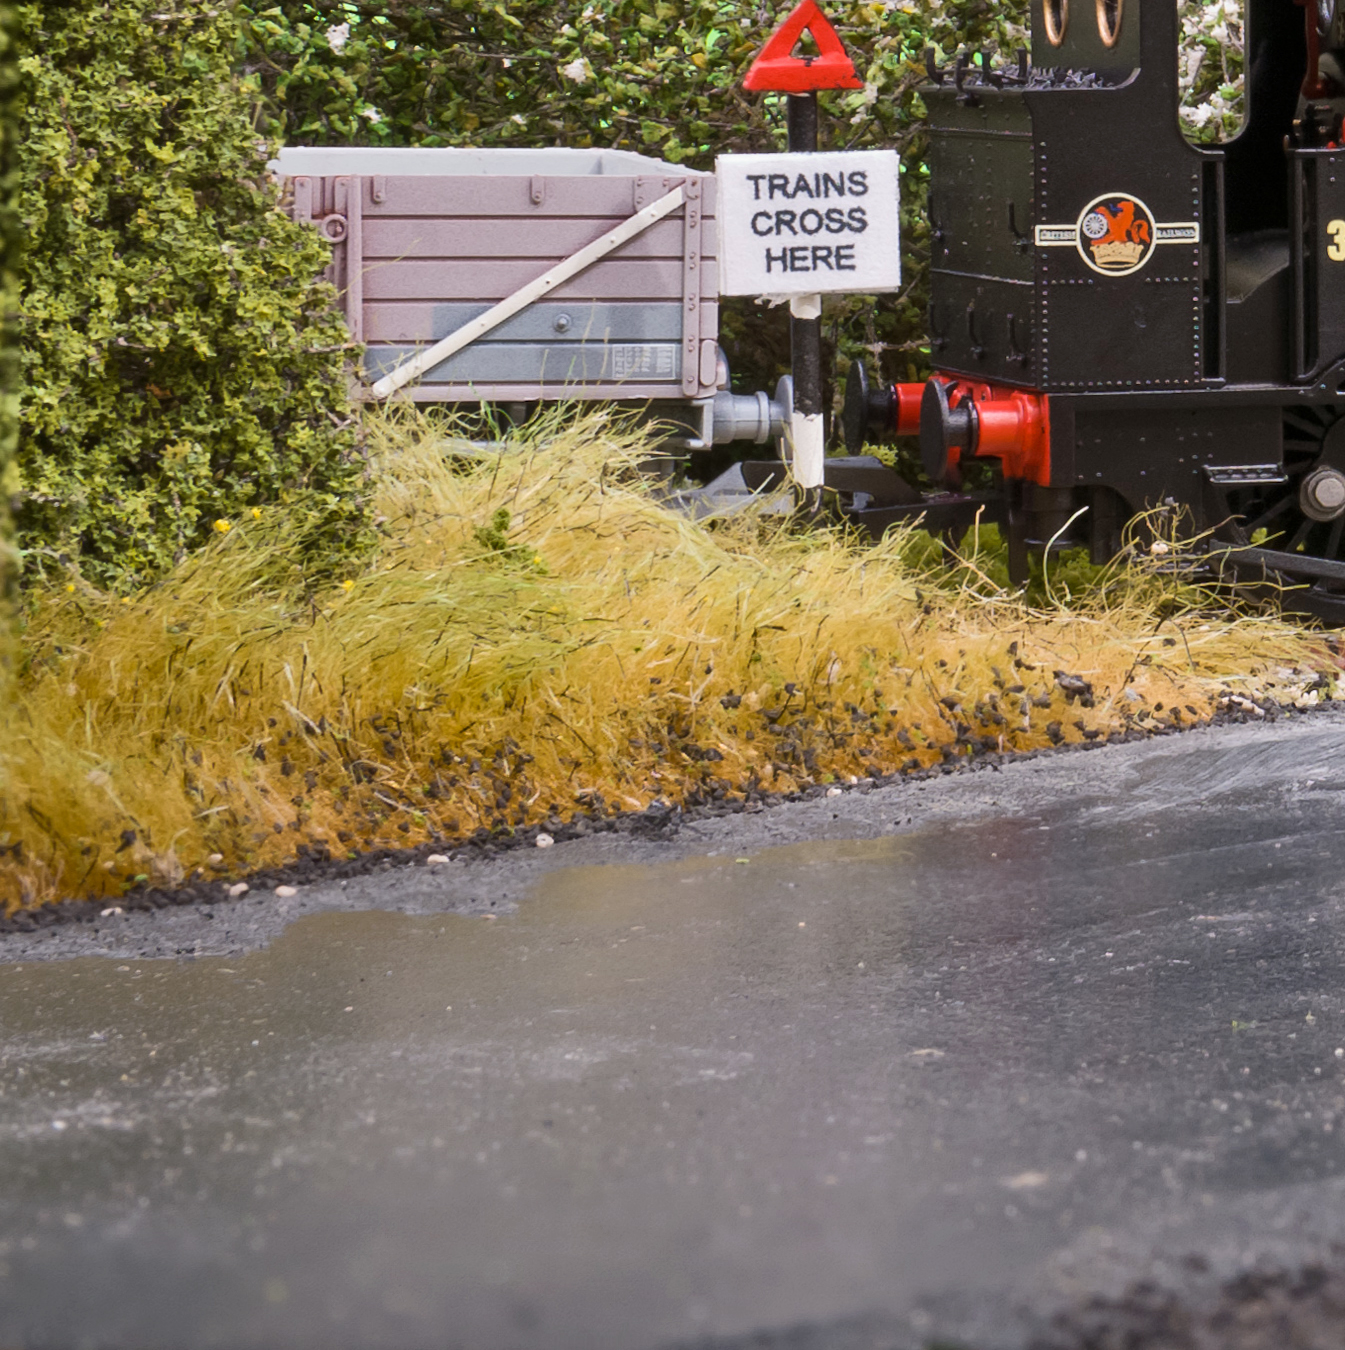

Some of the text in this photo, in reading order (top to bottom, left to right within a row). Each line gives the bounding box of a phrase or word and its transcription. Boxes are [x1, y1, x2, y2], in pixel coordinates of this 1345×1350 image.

[746, 170, 869, 200] TRAINS
[751, 206, 869, 237] CROSS
[765, 243, 857, 274] HERE
